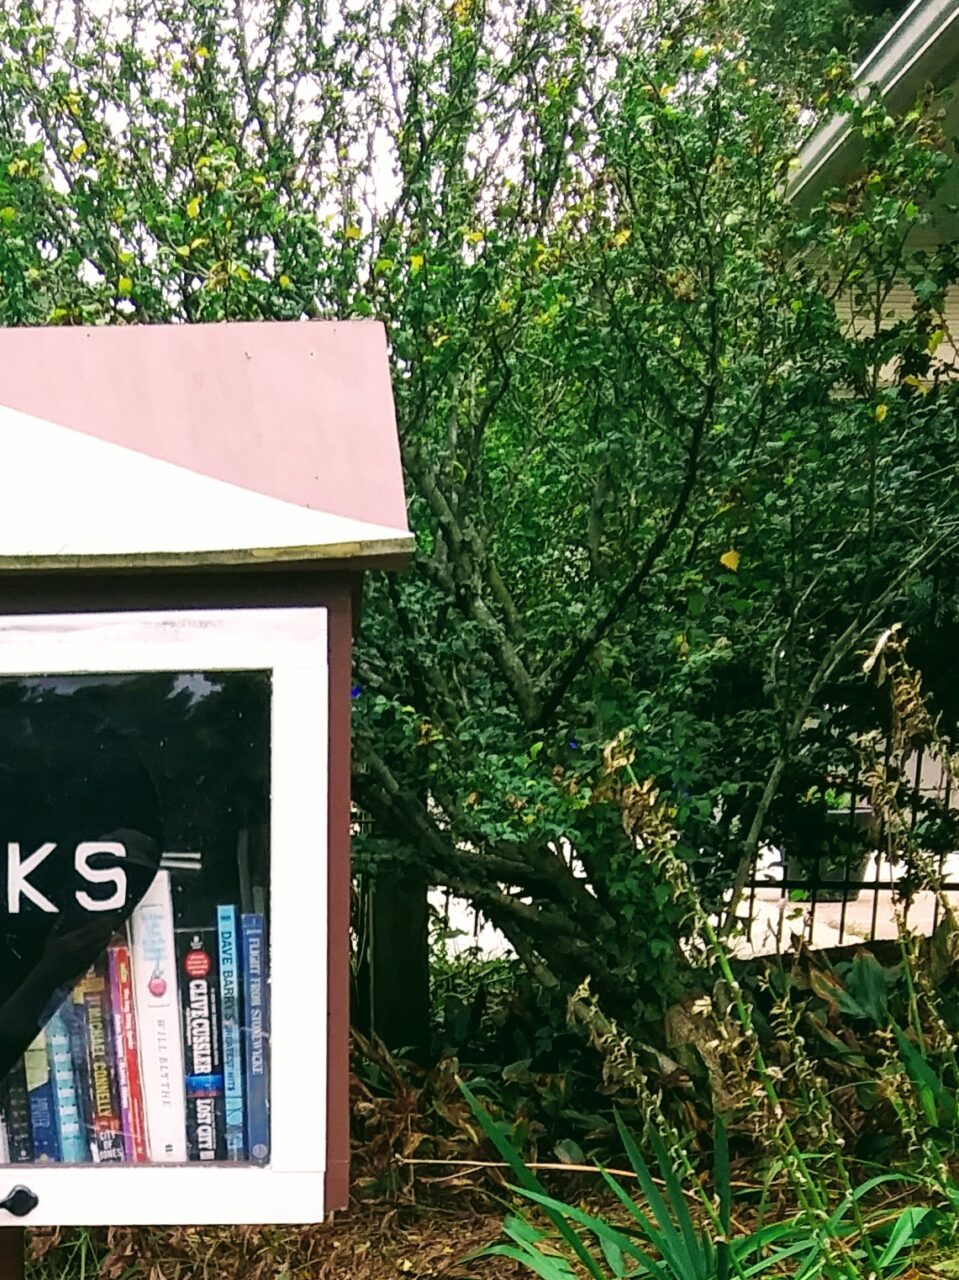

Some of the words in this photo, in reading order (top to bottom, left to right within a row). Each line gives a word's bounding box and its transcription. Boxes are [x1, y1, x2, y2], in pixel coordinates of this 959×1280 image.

[221, 930, 235, 966] DAVE
[248, 937, 261, 975] FLIGHT
[189, 979, 210, 1018] CLIVE
[250, 977, 262, 1006] FROM
[87, 1006, 106, 1058] MICHAEL
[156, 1018, 169, 1052] WILL
[191, 1018, 212, 1075] CUSSLER
[93, 1062, 113, 1117] CONNELLY
[159, 1056, 172, 1109] BLYTHE
[195, 1099, 212, 1124] LOST
[99, 1131, 117, 1141] CITY
[102, 1140, 113, 1150] OF
[197, 1124, 213, 1150] CITY
